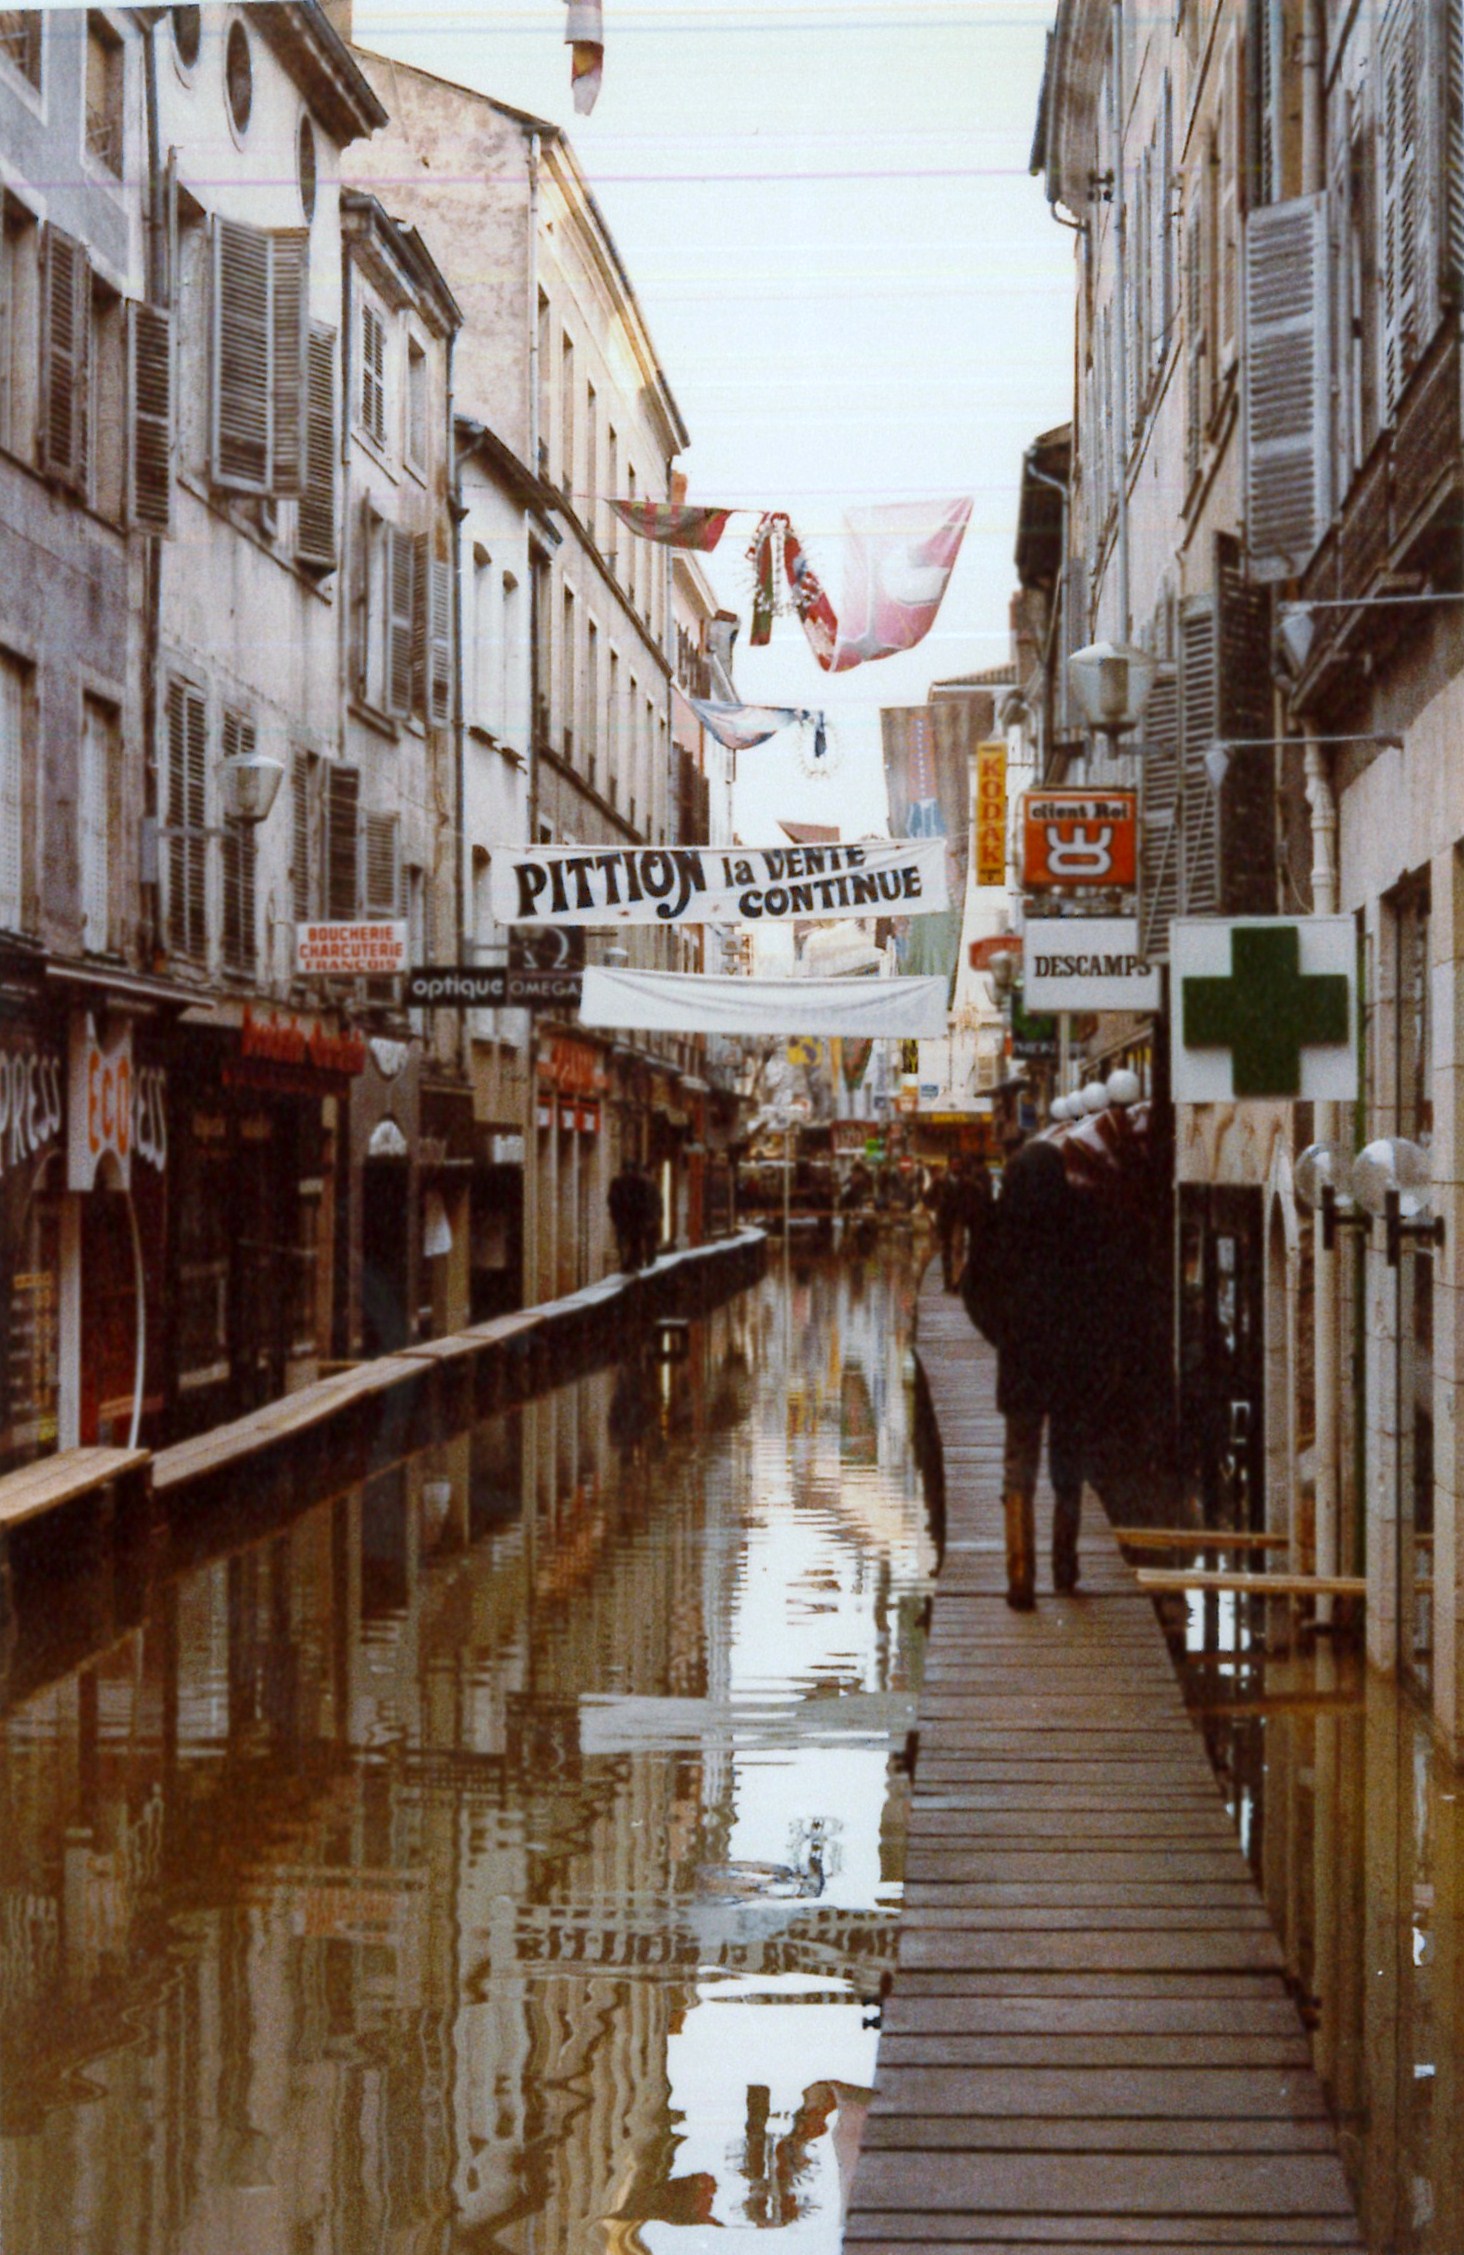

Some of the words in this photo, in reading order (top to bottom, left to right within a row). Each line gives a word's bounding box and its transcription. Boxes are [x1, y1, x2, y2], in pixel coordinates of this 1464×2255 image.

[982, 758, 1002, 864] KODAK
[1032, 803, 1087, 819] client
[513, 850, 706, 919] PITTION
[723, 857, 755, 888] la
[761, 845, 867, 881] VENTE
[739, 866, 923, 918] CONTINUE
[308, 926, 394, 941] BOUCHERIE
[299, 942, 403, 959] CHARCUTERIE
[412, 974, 503, 998] optique
[510, 981, 578, 996] OMEGA
